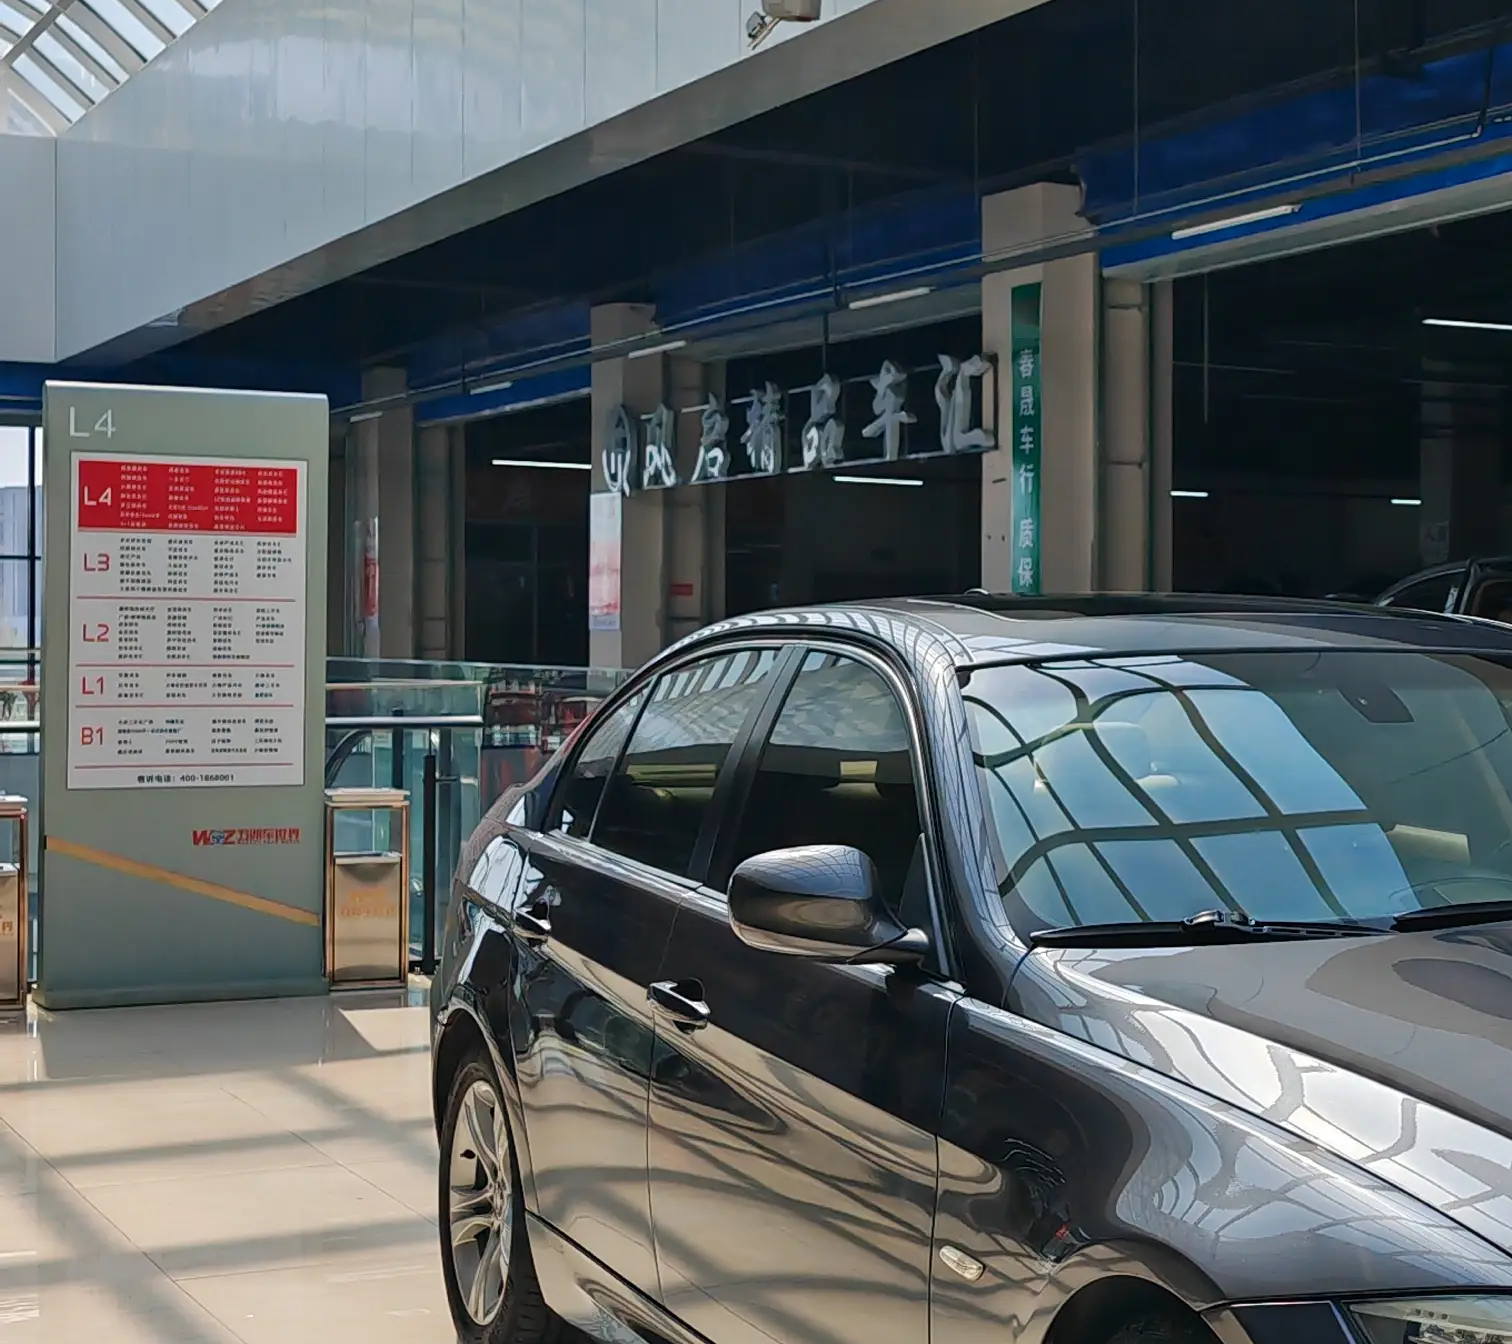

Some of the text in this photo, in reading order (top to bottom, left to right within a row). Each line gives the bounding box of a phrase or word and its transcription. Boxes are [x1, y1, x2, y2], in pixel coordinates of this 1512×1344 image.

[69, 406, 117, 439] L4
[83, 485, 113, 507] L4
[83, 552, 111, 572] L3
[82, 623, 110, 643] L2
[81, 675, 105, 695] L1
[81, 726, 105, 746] B1
